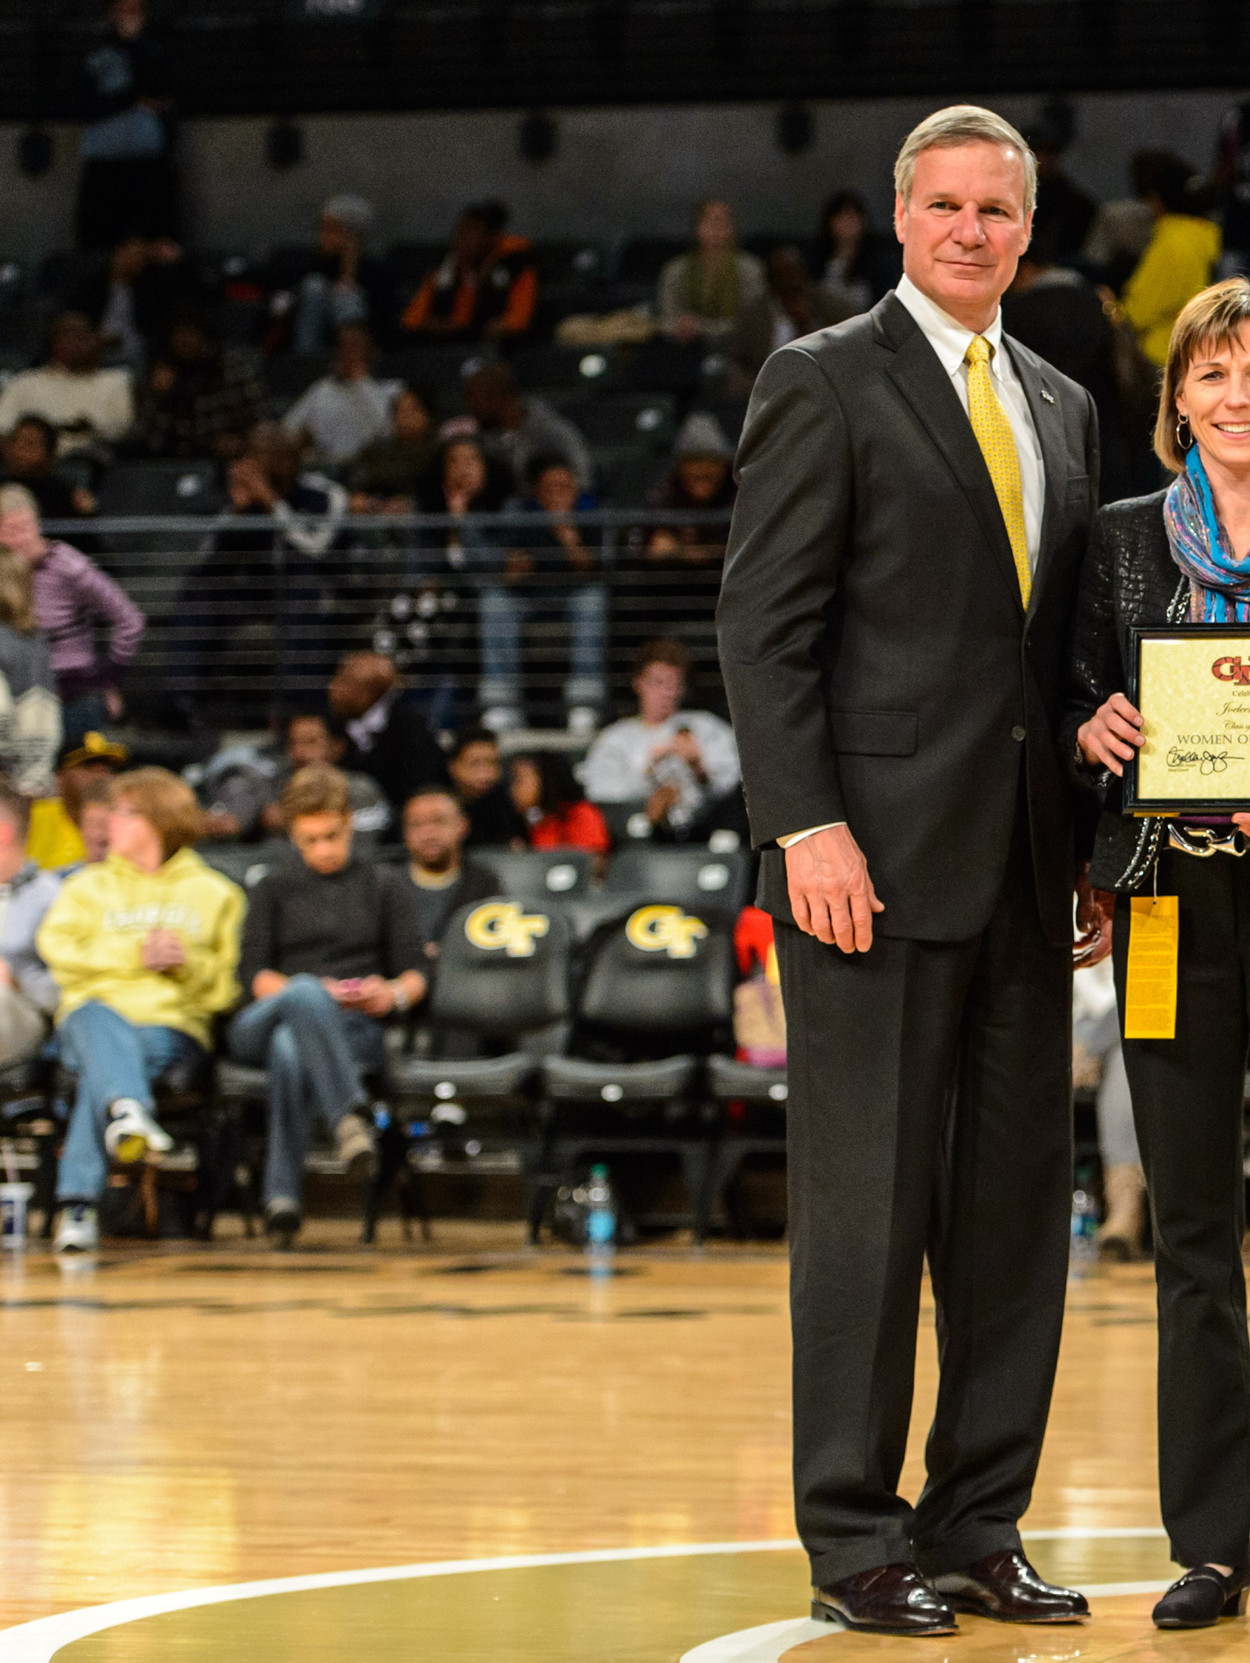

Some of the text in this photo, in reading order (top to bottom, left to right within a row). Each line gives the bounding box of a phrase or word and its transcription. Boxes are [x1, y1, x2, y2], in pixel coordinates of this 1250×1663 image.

[1177, 734, 1233, 745] WOMEN
[1223, 719, 1244, 730] Class
[464, 901, 550, 957] GT
[625, 903, 709, 960] GT
